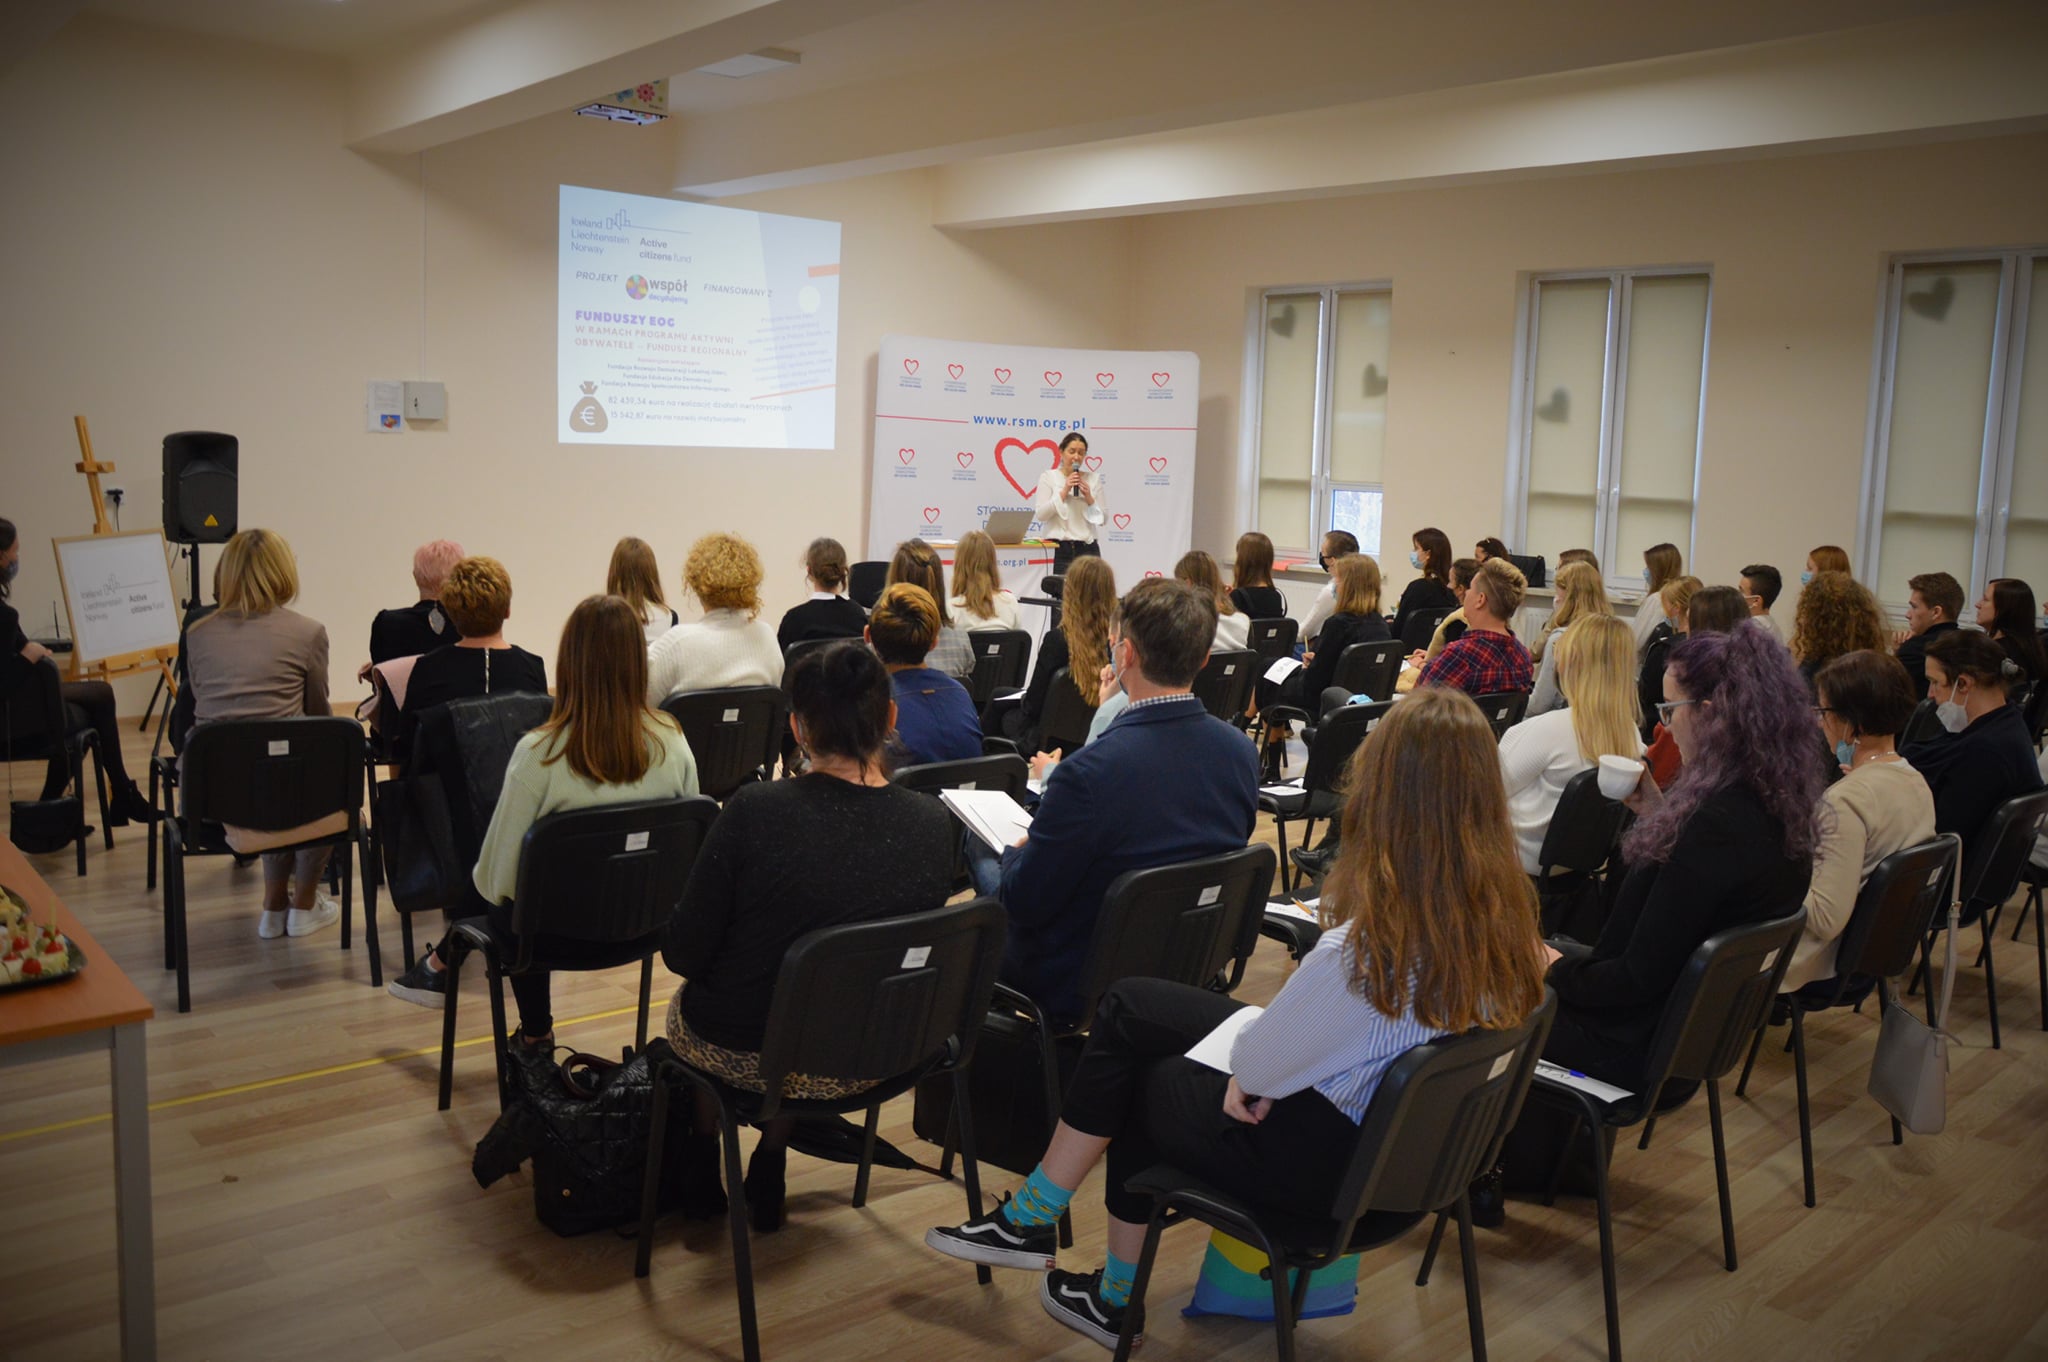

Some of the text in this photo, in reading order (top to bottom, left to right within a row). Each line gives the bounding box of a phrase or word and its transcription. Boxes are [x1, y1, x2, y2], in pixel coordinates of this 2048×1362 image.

[571, 216, 602, 228] Iceland
[571, 229, 629, 245] Liechtenstein
[639, 237, 668, 249] Active
[571, 241, 604, 255] Norway
[639, 250, 672, 262] citizens
[575, 270, 618, 283] PROJEKT
[649, 279, 688, 294] współ
[703, 283, 767, 297] FINANSOWANY
[575, 309, 646, 325] FUNDUSZY
[575, 325, 585, 334] W
[588, 326, 632, 337] RAMACH
[635, 328, 689, 341] PROGRAMU
[690, 333, 735, 344] AKTYWNI
[575, 337, 634, 350] OBYWATELE
[646, 342, 688, 353] FUNDUSZ
[690, 345, 748, 357] REGIONALNY
[973, 415, 1087, 431] www.rsm.org.pl
